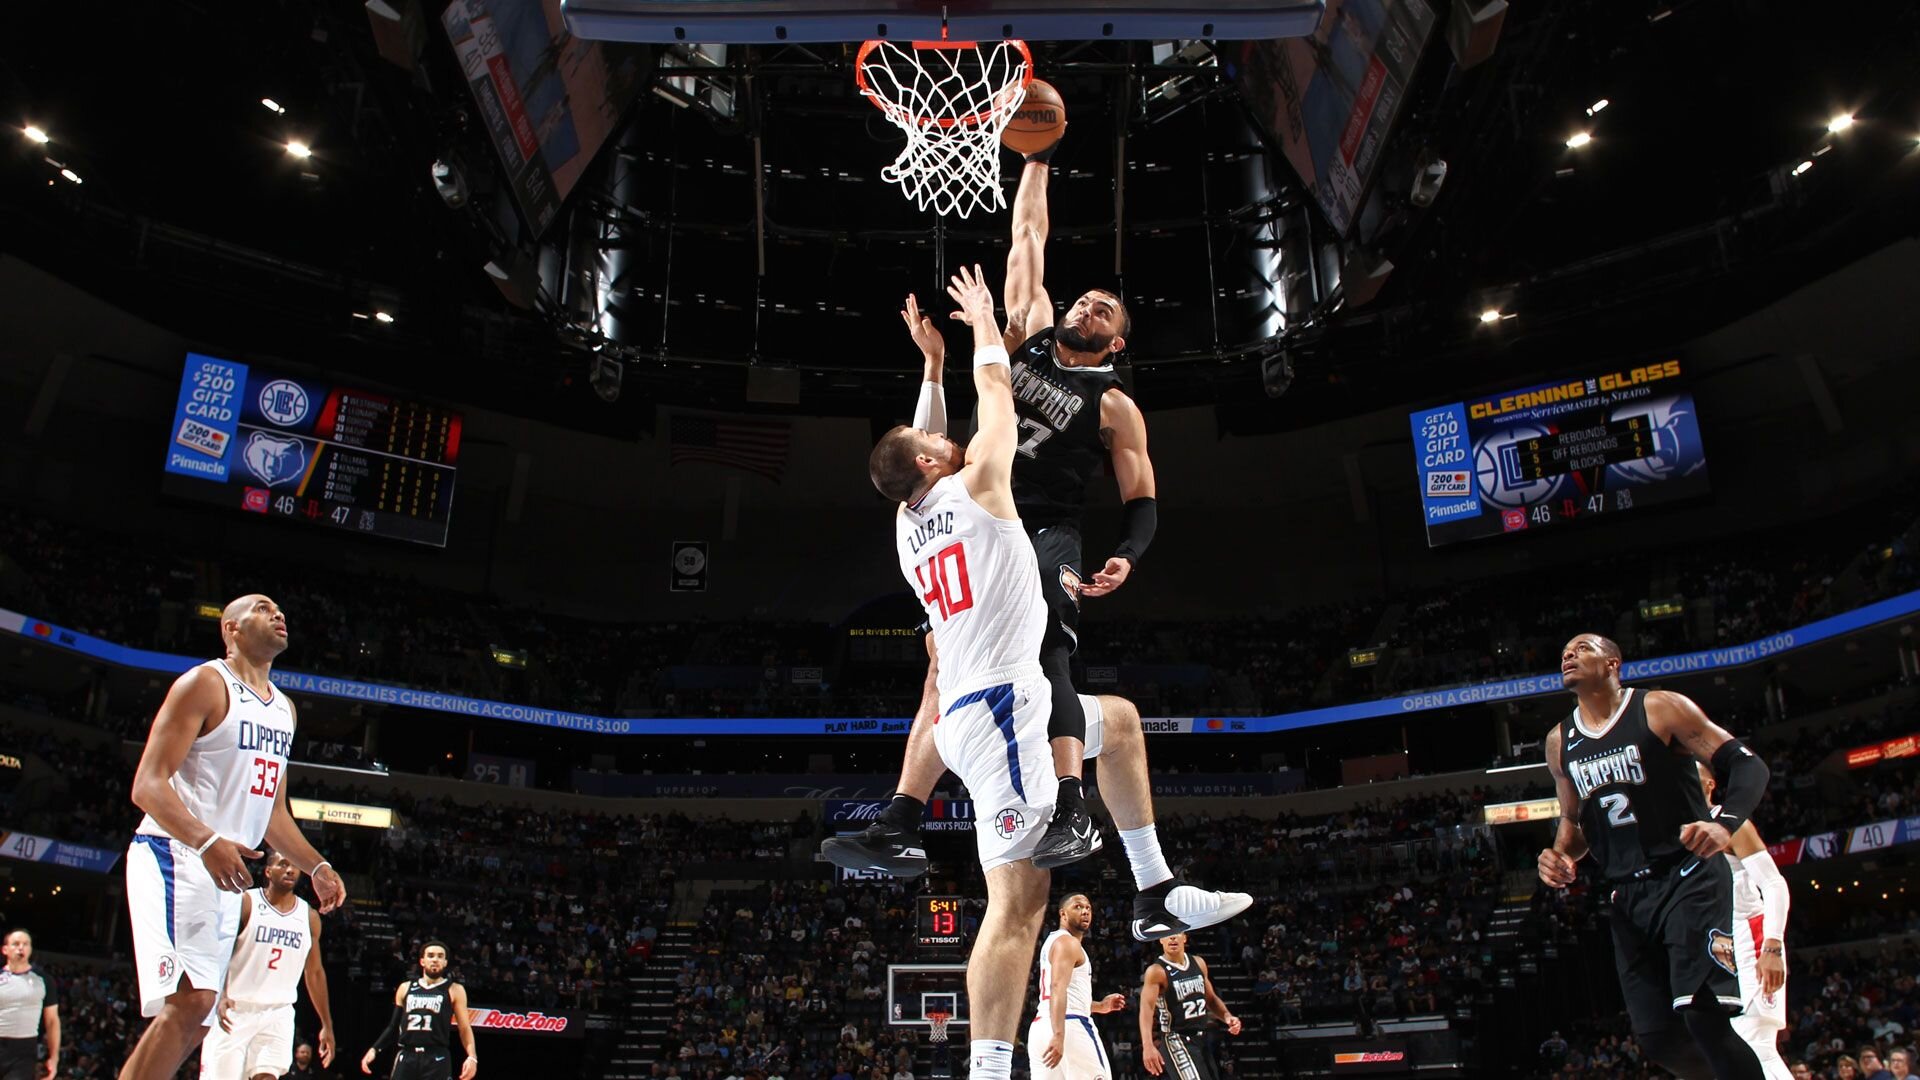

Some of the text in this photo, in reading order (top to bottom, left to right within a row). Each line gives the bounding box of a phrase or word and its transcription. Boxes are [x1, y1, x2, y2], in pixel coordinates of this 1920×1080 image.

[202, 363, 233, 377] GET A
[193, 371, 235, 392] $200
[1470, 360, 1681, 420] CLEANING THE GLASS
[193, 388, 232, 406] GIFT
[1011, 361, 1084, 432] MEMPHIS
[1493, 413, 1524, 424] PRESENTED
[1530, 398, 1600, 420] ServiceMASTER
[1601, 396, 1610, 406] by
[1611, 386, 1651, 402] STRATOS
[185, 402, 231, 422] CARD
[1426, 411, 1454, 425] GET A
[187, 422, 209, 438] $200
[1015, 412, 1054, 459] 7
[1422, 420, 1458, 439] $200
[1529, 419, 1638, 451] 15 REBOUNDS 16
[182, 432, 221, 451] GIFT CARD
[1426, 435, 1459, 453] GIFT
[1552, 448, 1570, 460] OFF
[1570, 437, 1618, 457] REBOUNDS
[171, 453, 225, 475] Pinnacle
[1424, 449, 1465, 468] CARD
[1570, 454, 1605, 471] BLOCKS
[1431, 474, 1452, 483] $200
[274, 495, 295, 515] 46
[331, 506, 350, 525] 47
[1429, 500, 1477, 518] Pinnacle
[1532, 504, 1551, 523] 46
[1588, 493, 1604, 513] 47
[907, 511, 954, 555] ZUBAC
[914, 540, 974, 622] 40
[1402, 695, 1442, 711] OPEN
[1446, 693, 1457, 705] A
[1459, 680, 1536, 702] GRIZZLIES
[1627, 654, 1709, 680] ACCOUNT
[1712, 646, 1756, 667] WITH
[1758, 633, 1794, 655] $100
[272, 671, 630, 734] PEN A GRIZZLIES CHECKING ACCOUNT WITH $100
[825, 722, 848, 732] PLAY
[851, 720, 878, 731] HARD
[882, 722, 905, 732] Bank
[238, 720, 292, 759] CLIPPERS
[250, 757, 279, 798] 33
[1568, 743, 1647, 800] MEMPHIS
[1156, 785, 1255, 794] ONLY WORTH IT
[328, 810, 362, 820] LOTTERY
[1599, 793, 1638, 828] 2
[926, 821, 973, 831] HUSKY'S PIZZA
[1863, 825, 1884, 848] 40
[14, 836, 36, 859] 40
[929, 900, 958, 912] 6:41
[933, 912, 955, 934] 13
[255, 925, 302, 950] CLIPPERS
[268, 948, 282, 970] 2
[1172, 974, 1206, 1001] MEMPHIS
[406, 993, 443, 1014] MEMPHIS
[1183, 998, 1207, 1020] 22
[407, 1014, 432, 1031] 21
[483, 1009, 568, 1032] AutoZone
